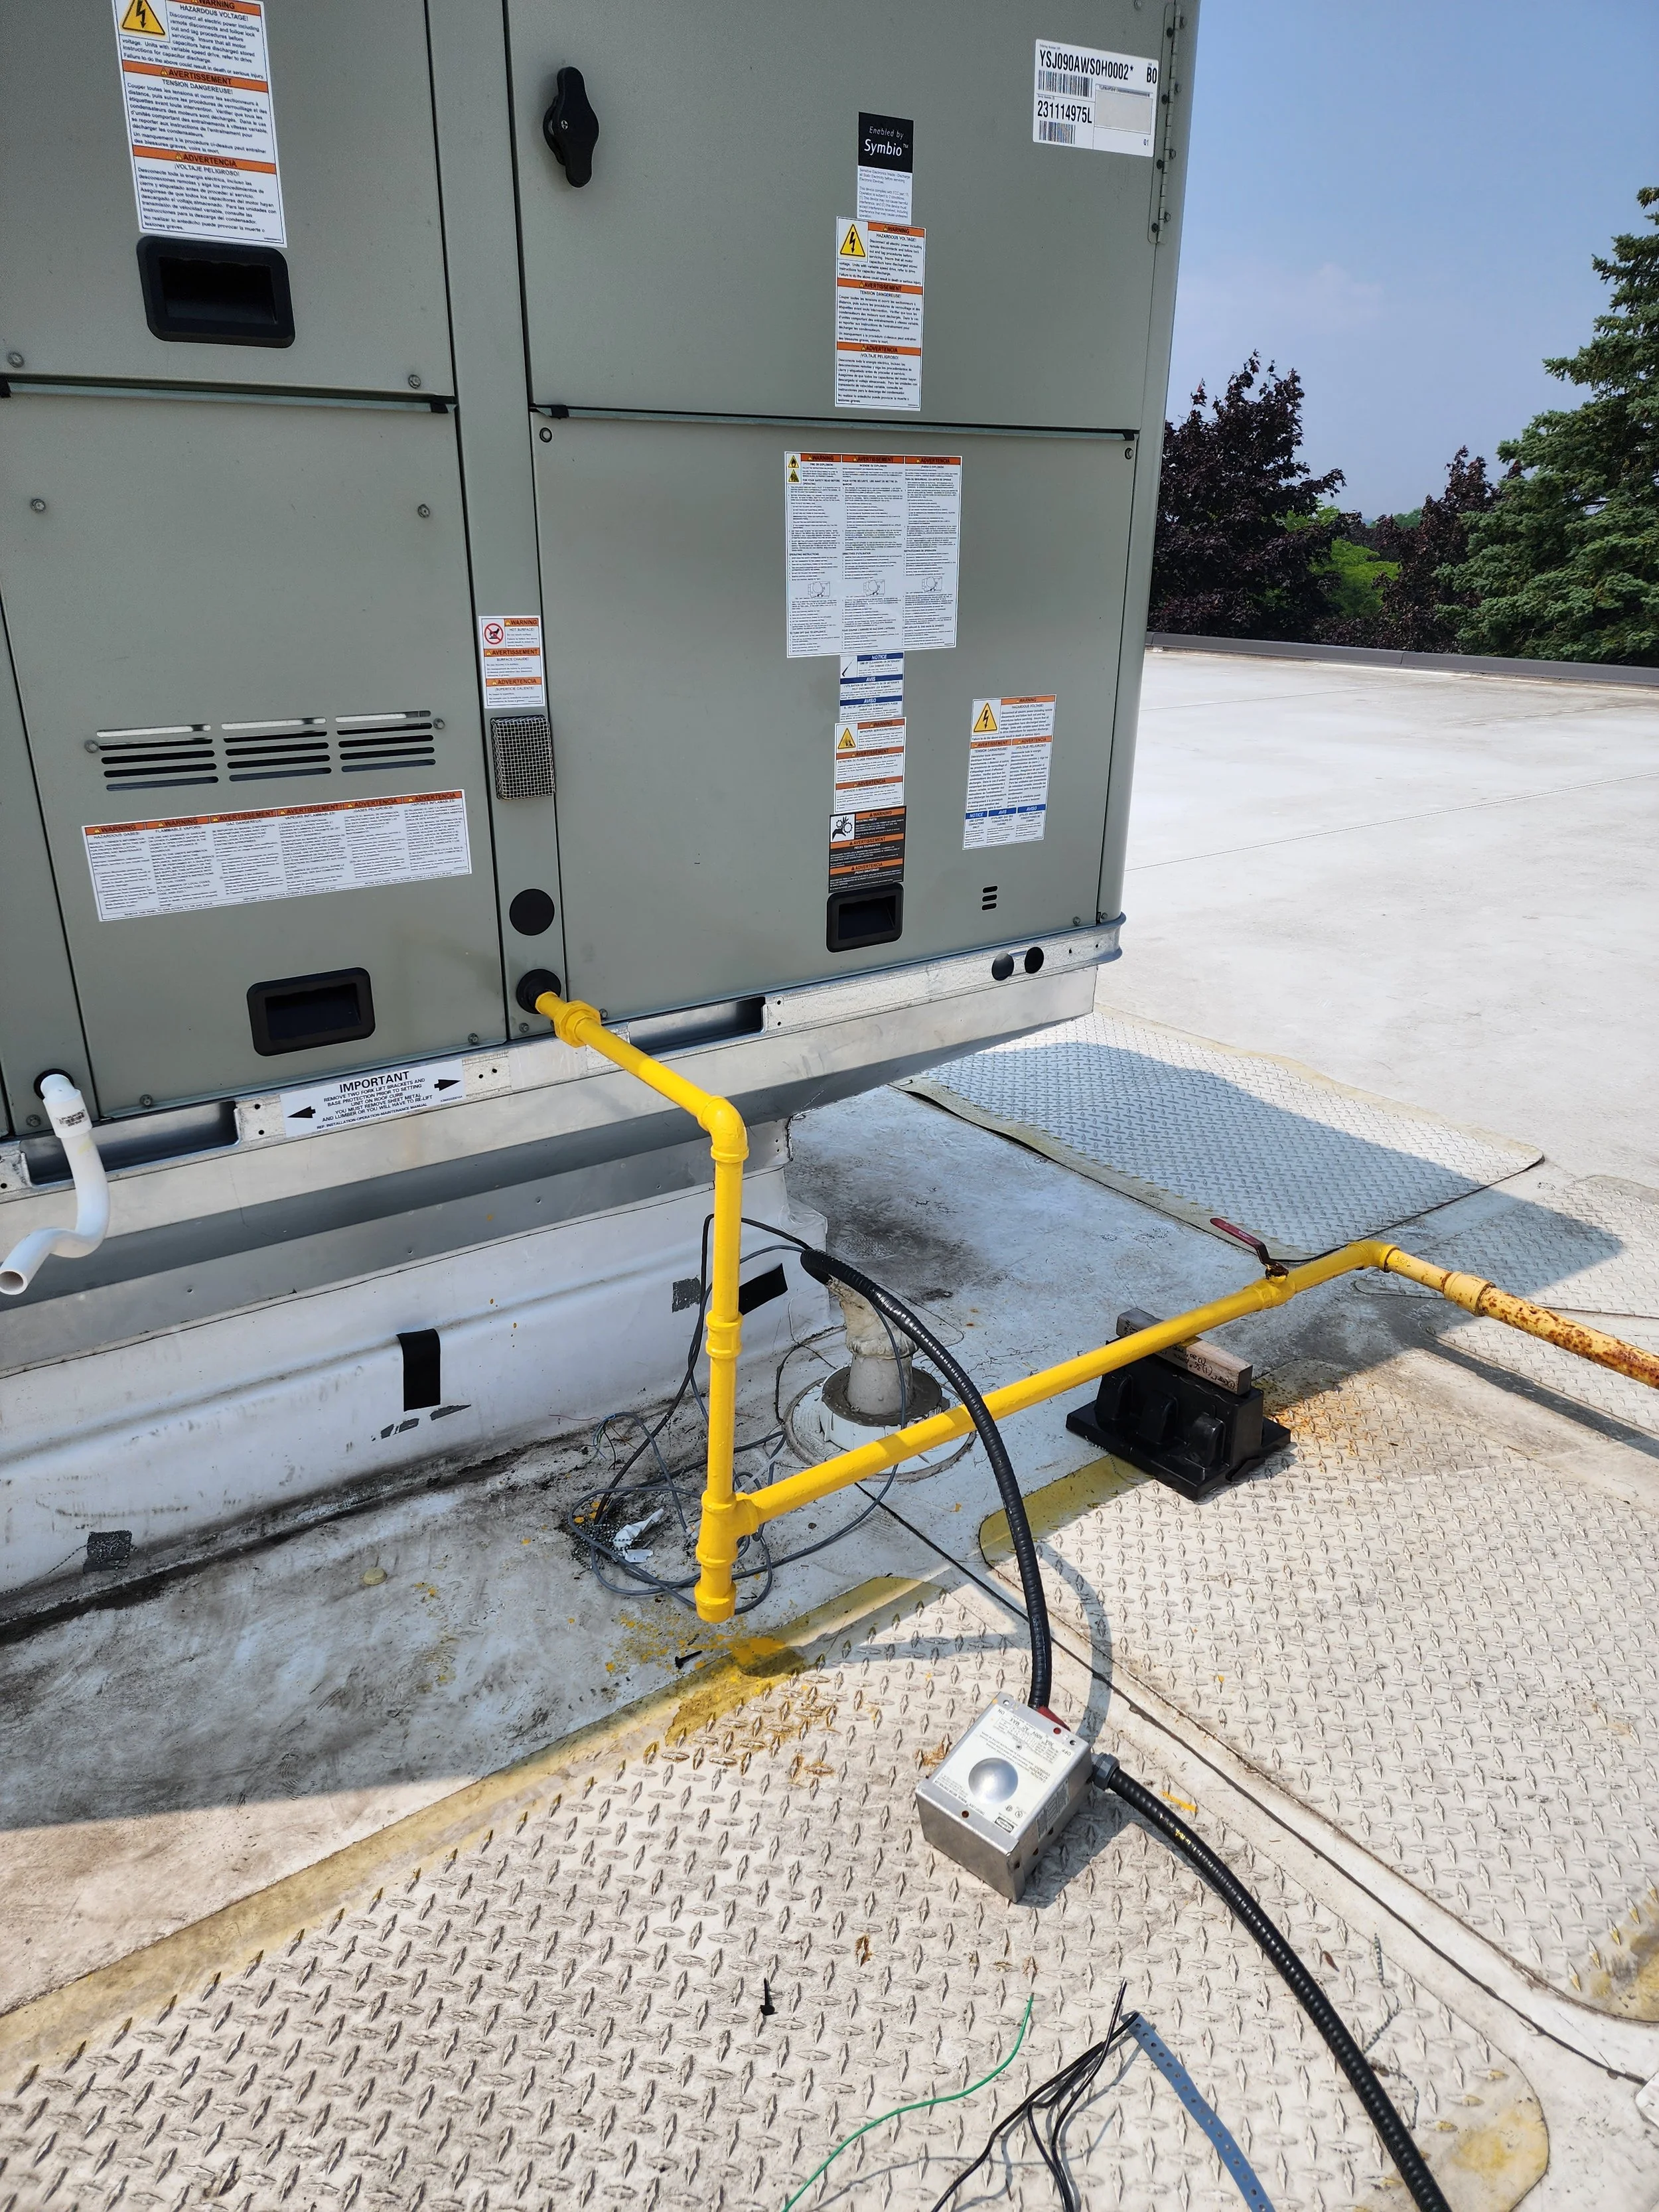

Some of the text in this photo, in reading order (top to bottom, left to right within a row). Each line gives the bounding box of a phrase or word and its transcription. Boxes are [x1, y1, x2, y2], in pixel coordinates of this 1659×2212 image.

[198, 0, 235, 10] WARNING
[180, 5, 248, 21] HAZARDOUS VOLTAGE!
[169, 11, 196, 21] Disconnect
[238, 23, 259, 31] including
[188, 22, 218, 31] disconnects
[171, 33, 194, 41] servicing.
[200, 31, 227, 40] procedures
[121, 38, 141, 46] voltage.
[172, 40, 198, 48] capacitors
[212, 46, 238, 54] discharged
[162, 51, 184, 60] capacitor
[186, 54, 211, 64] discharge.
[169, 69, 232, 85] AVERTISSEMENT
[1146, 66, 1157, 84] B0
[162, 78, 232, 94] TENSION DANGEREUSE!
[1037, 100, 1092, 123] 231114975L
[869, 125, 903, 142] Enabled by
[183, 153, 237, 167] ADVERTENCIA
[203, 167, 240, 176] PELIGROSO!
[864, 282, 901, 291] AVERTISSEMENT
[354, 799, 397, 808] ADVERTENCIA
[286, 804, 338, 814] AVERTISSEMENT
[220, 811, 273, 821] AVERTISSEMENT
[101, 824, 135, 833] WARNING
[339, 1070, 409, 1093] IMPORTANT
[323, 1094, 346, 1102] REMOVE
[387, 1080, 413, 1089] BRACKETS
[342, 1093, 375, 1104] PROTECTION
[364, 1100, 386, 1108] REMOVE
[334, 1111, 356, 1120] LUMBER
